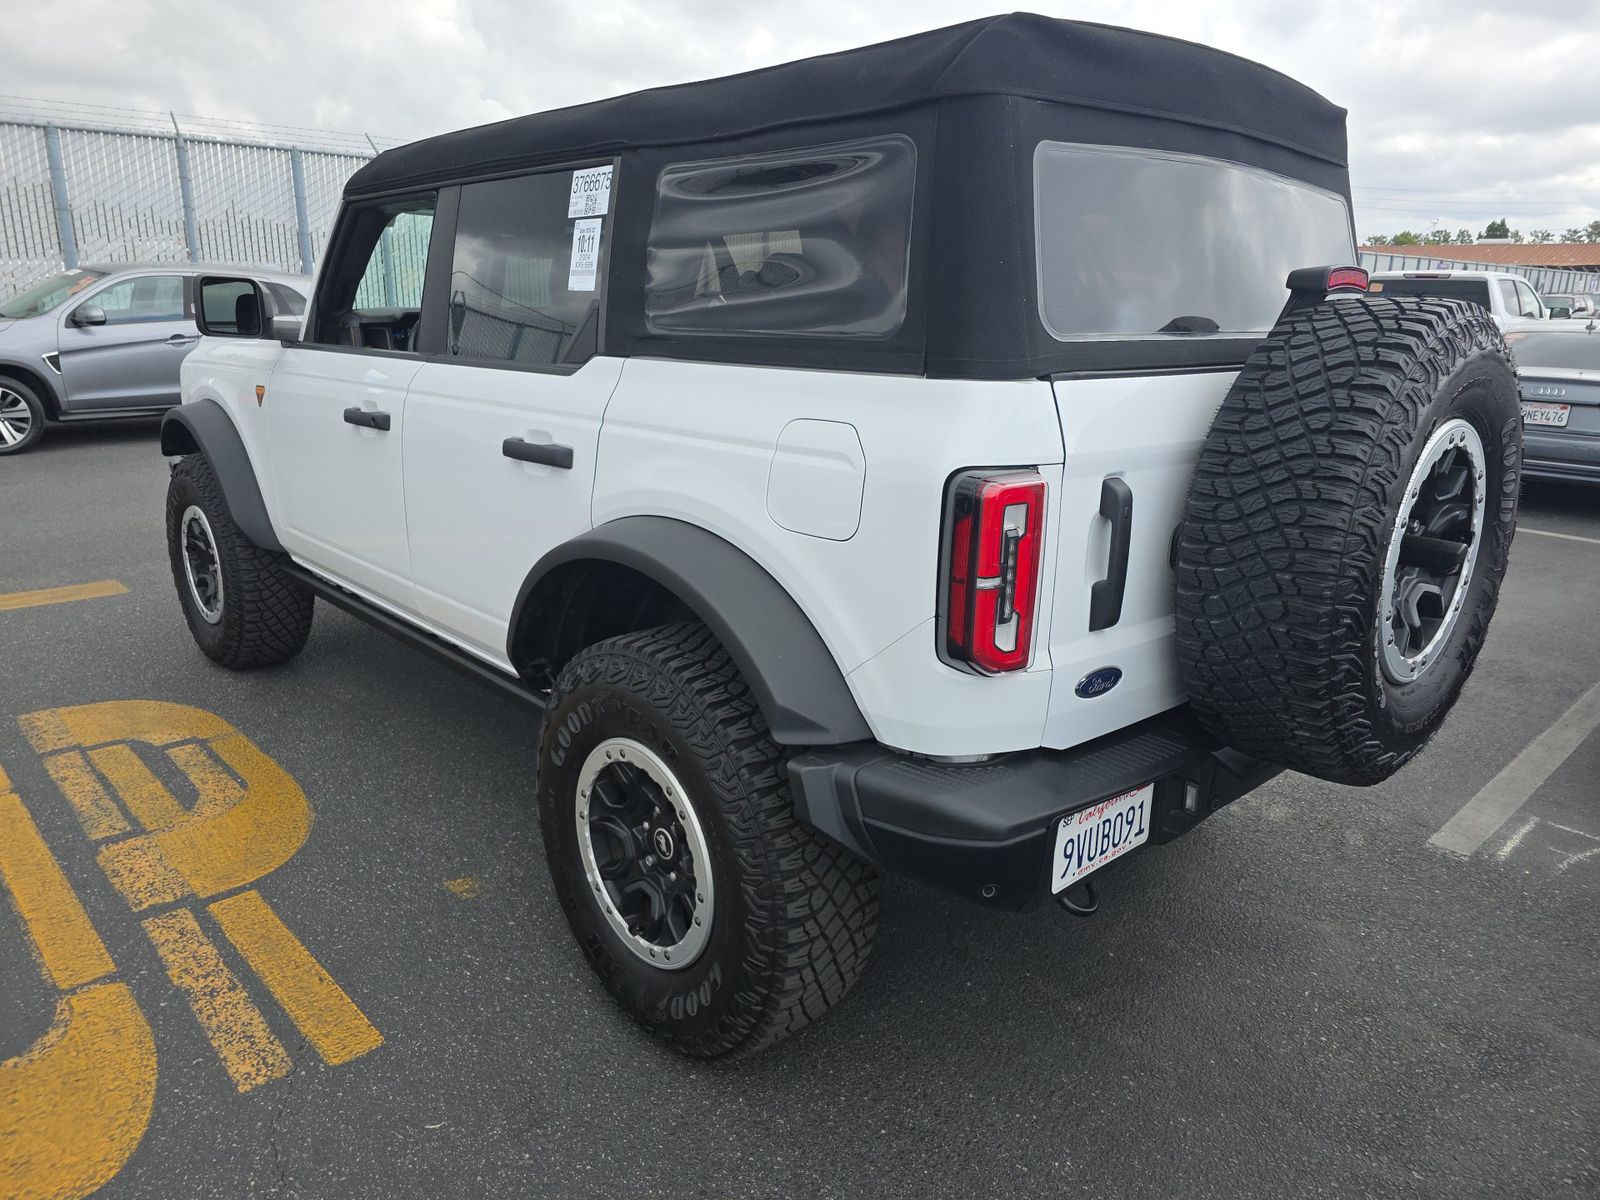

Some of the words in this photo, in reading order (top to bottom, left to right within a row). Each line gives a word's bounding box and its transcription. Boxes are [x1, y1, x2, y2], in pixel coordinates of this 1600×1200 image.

[573, 172, 612, 193] 3766675
[1088, 675, 1115, 693] Ford
[1060, 800, 1144, 880] 9VUB091
